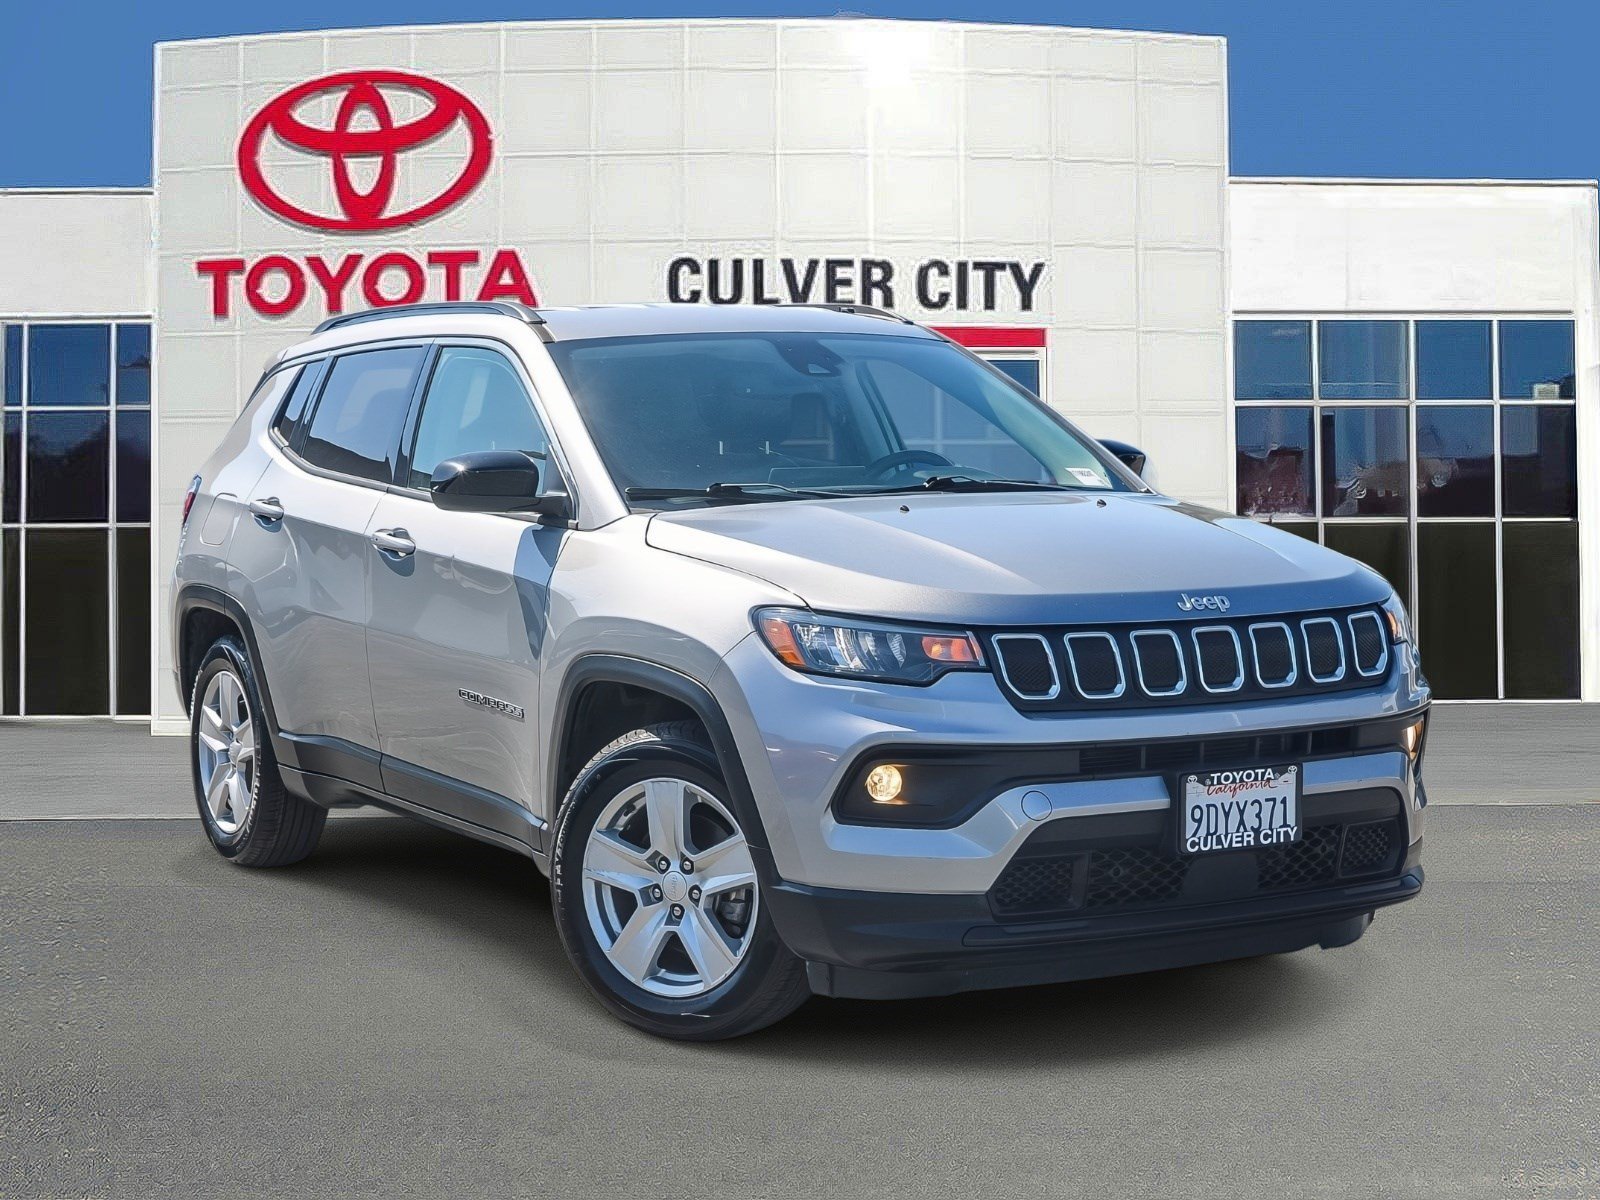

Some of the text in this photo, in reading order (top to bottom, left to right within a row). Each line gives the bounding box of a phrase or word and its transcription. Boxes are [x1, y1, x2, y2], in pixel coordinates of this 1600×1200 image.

[195, 249, 538, 317] TOYOTA
[668, 256, 1046, 312] CULVER CITY
[1177, 593, 1231, 612] Jeep
[458, 688, 525, 719] COMPASS
[1207, 780, 1278, 798] California
[1210, 768, 1275, 786] TOYOTA
[1190, 796, 1291, 838] 9DYX371
[1186, 826, 1298, 853] CULVER CITY
